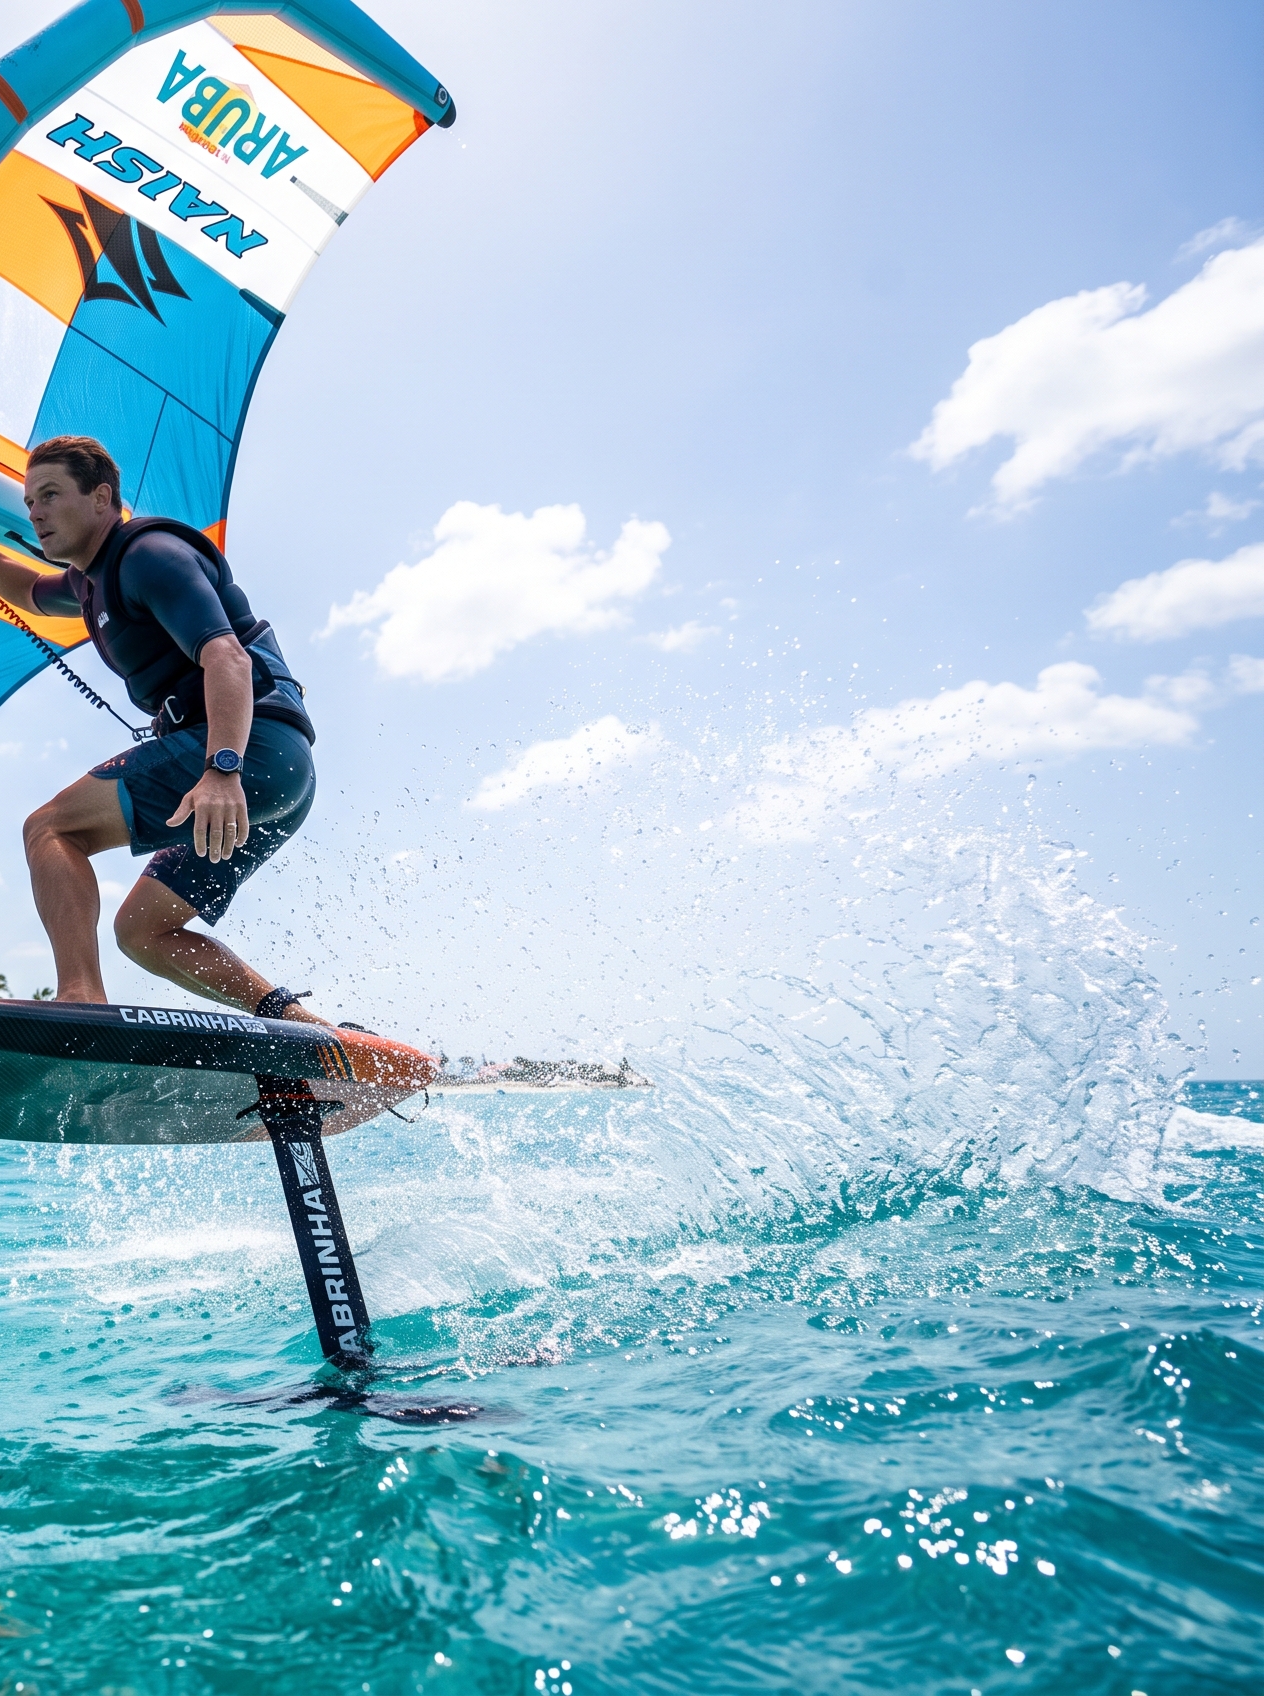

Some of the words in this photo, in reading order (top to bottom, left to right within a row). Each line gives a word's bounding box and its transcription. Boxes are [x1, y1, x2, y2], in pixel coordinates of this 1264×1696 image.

[156, 49, 308, 179] ARUBA
[46, 113, 268, 258] NAISH
[120, 1008, 243, 1032] CABRINHA
[304, 1187, 361, 1351] ABRINHA
